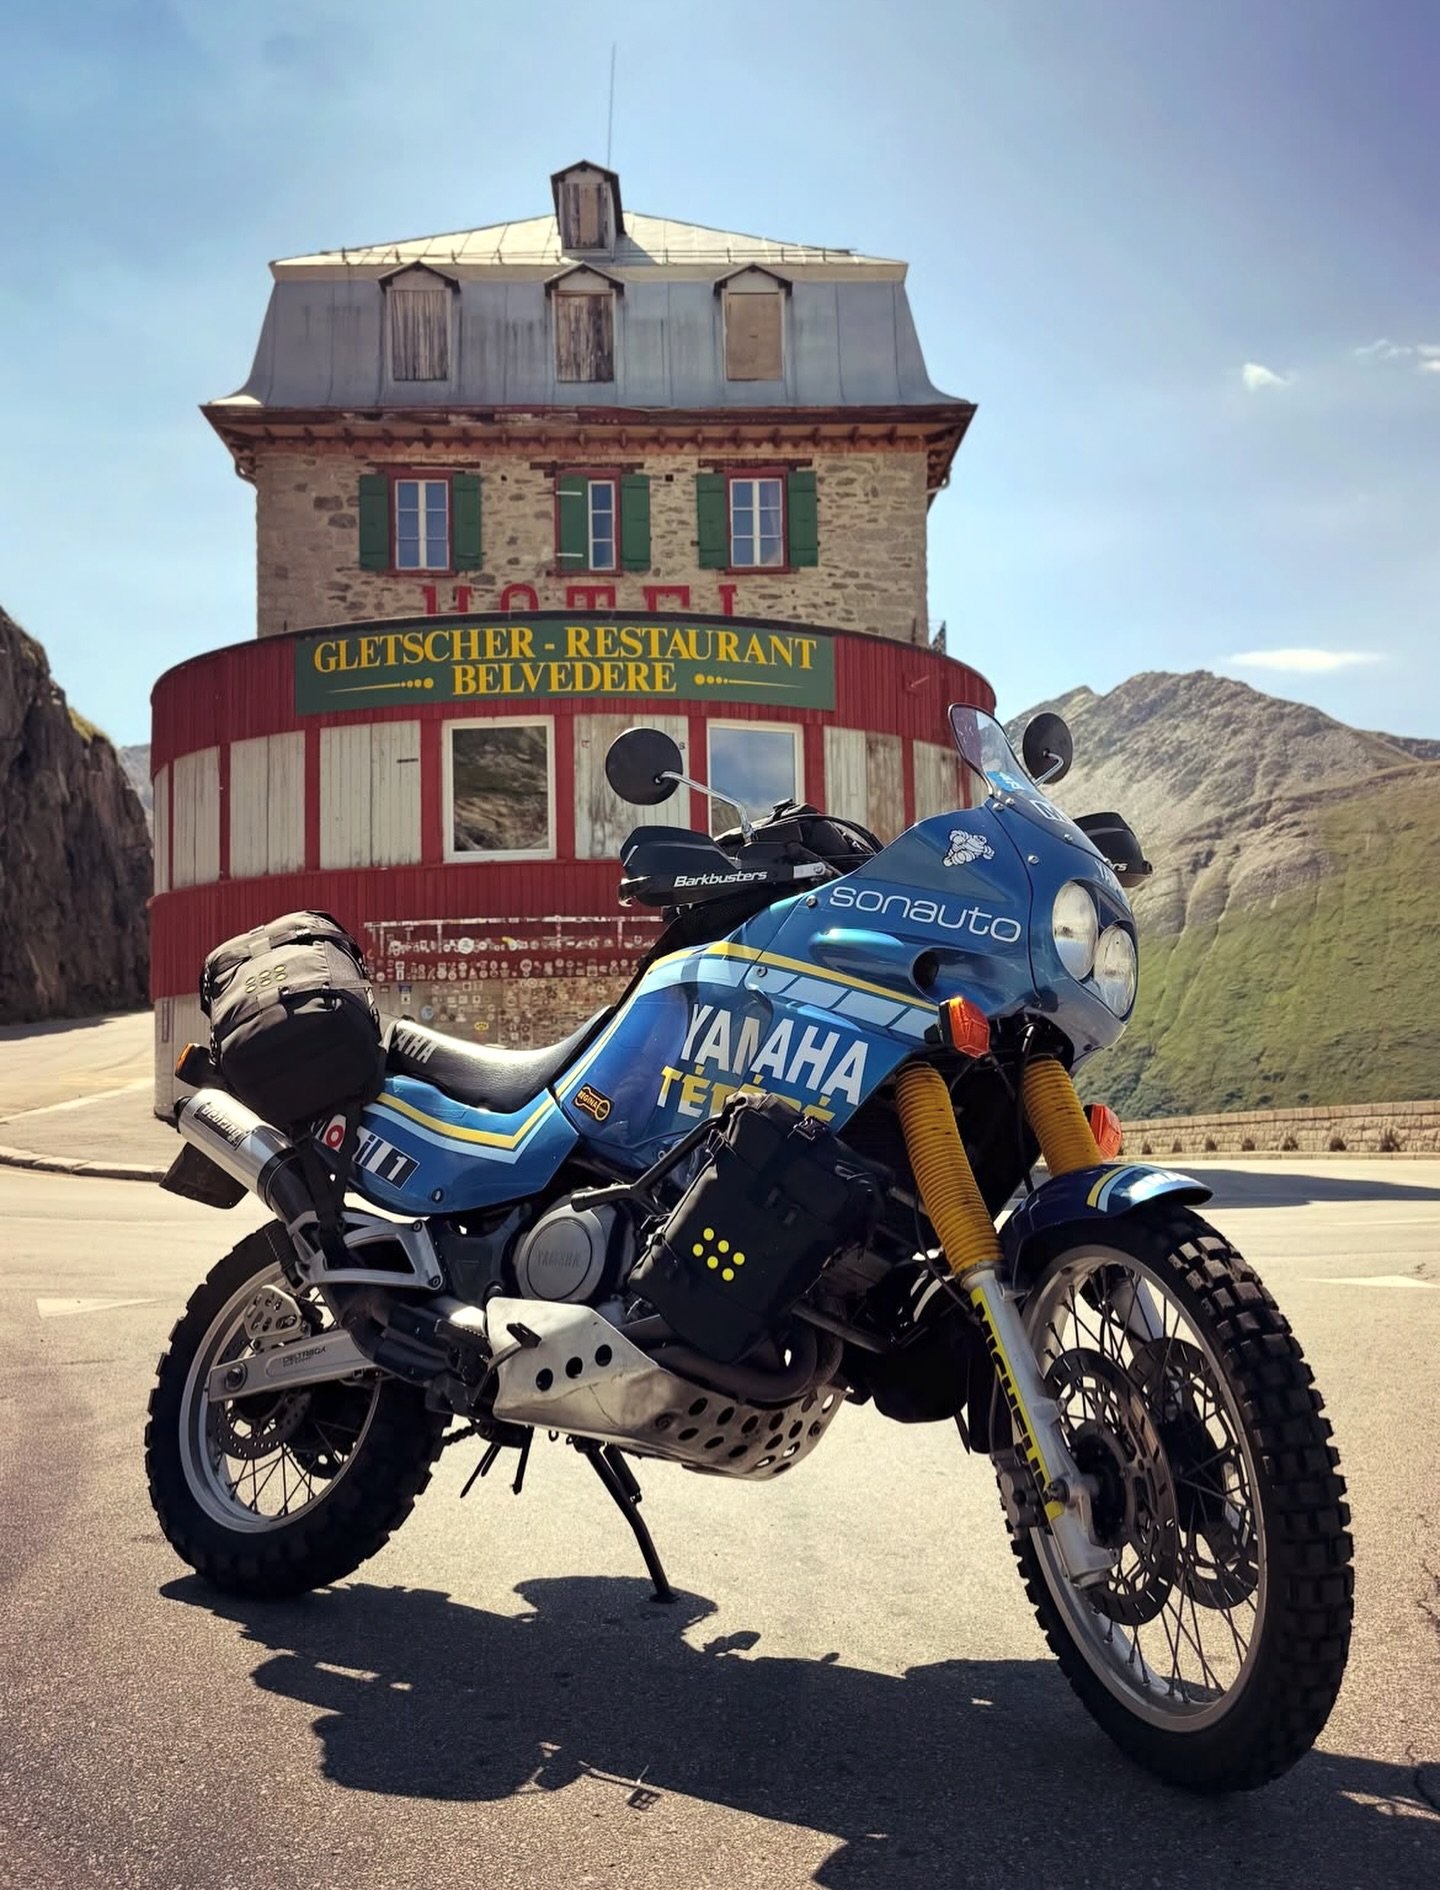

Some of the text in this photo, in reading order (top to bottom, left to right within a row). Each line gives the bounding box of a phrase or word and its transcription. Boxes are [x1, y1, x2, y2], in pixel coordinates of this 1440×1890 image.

[313, 627, 533, 674] GLETSCHER
[564, 626, 818, 670] RESTAURANT
[452, 662, 678, 696] BELVEDERE
[673, 868, 768, 888] Barkbusters
[829, 885, 1022, 943] sonauto
